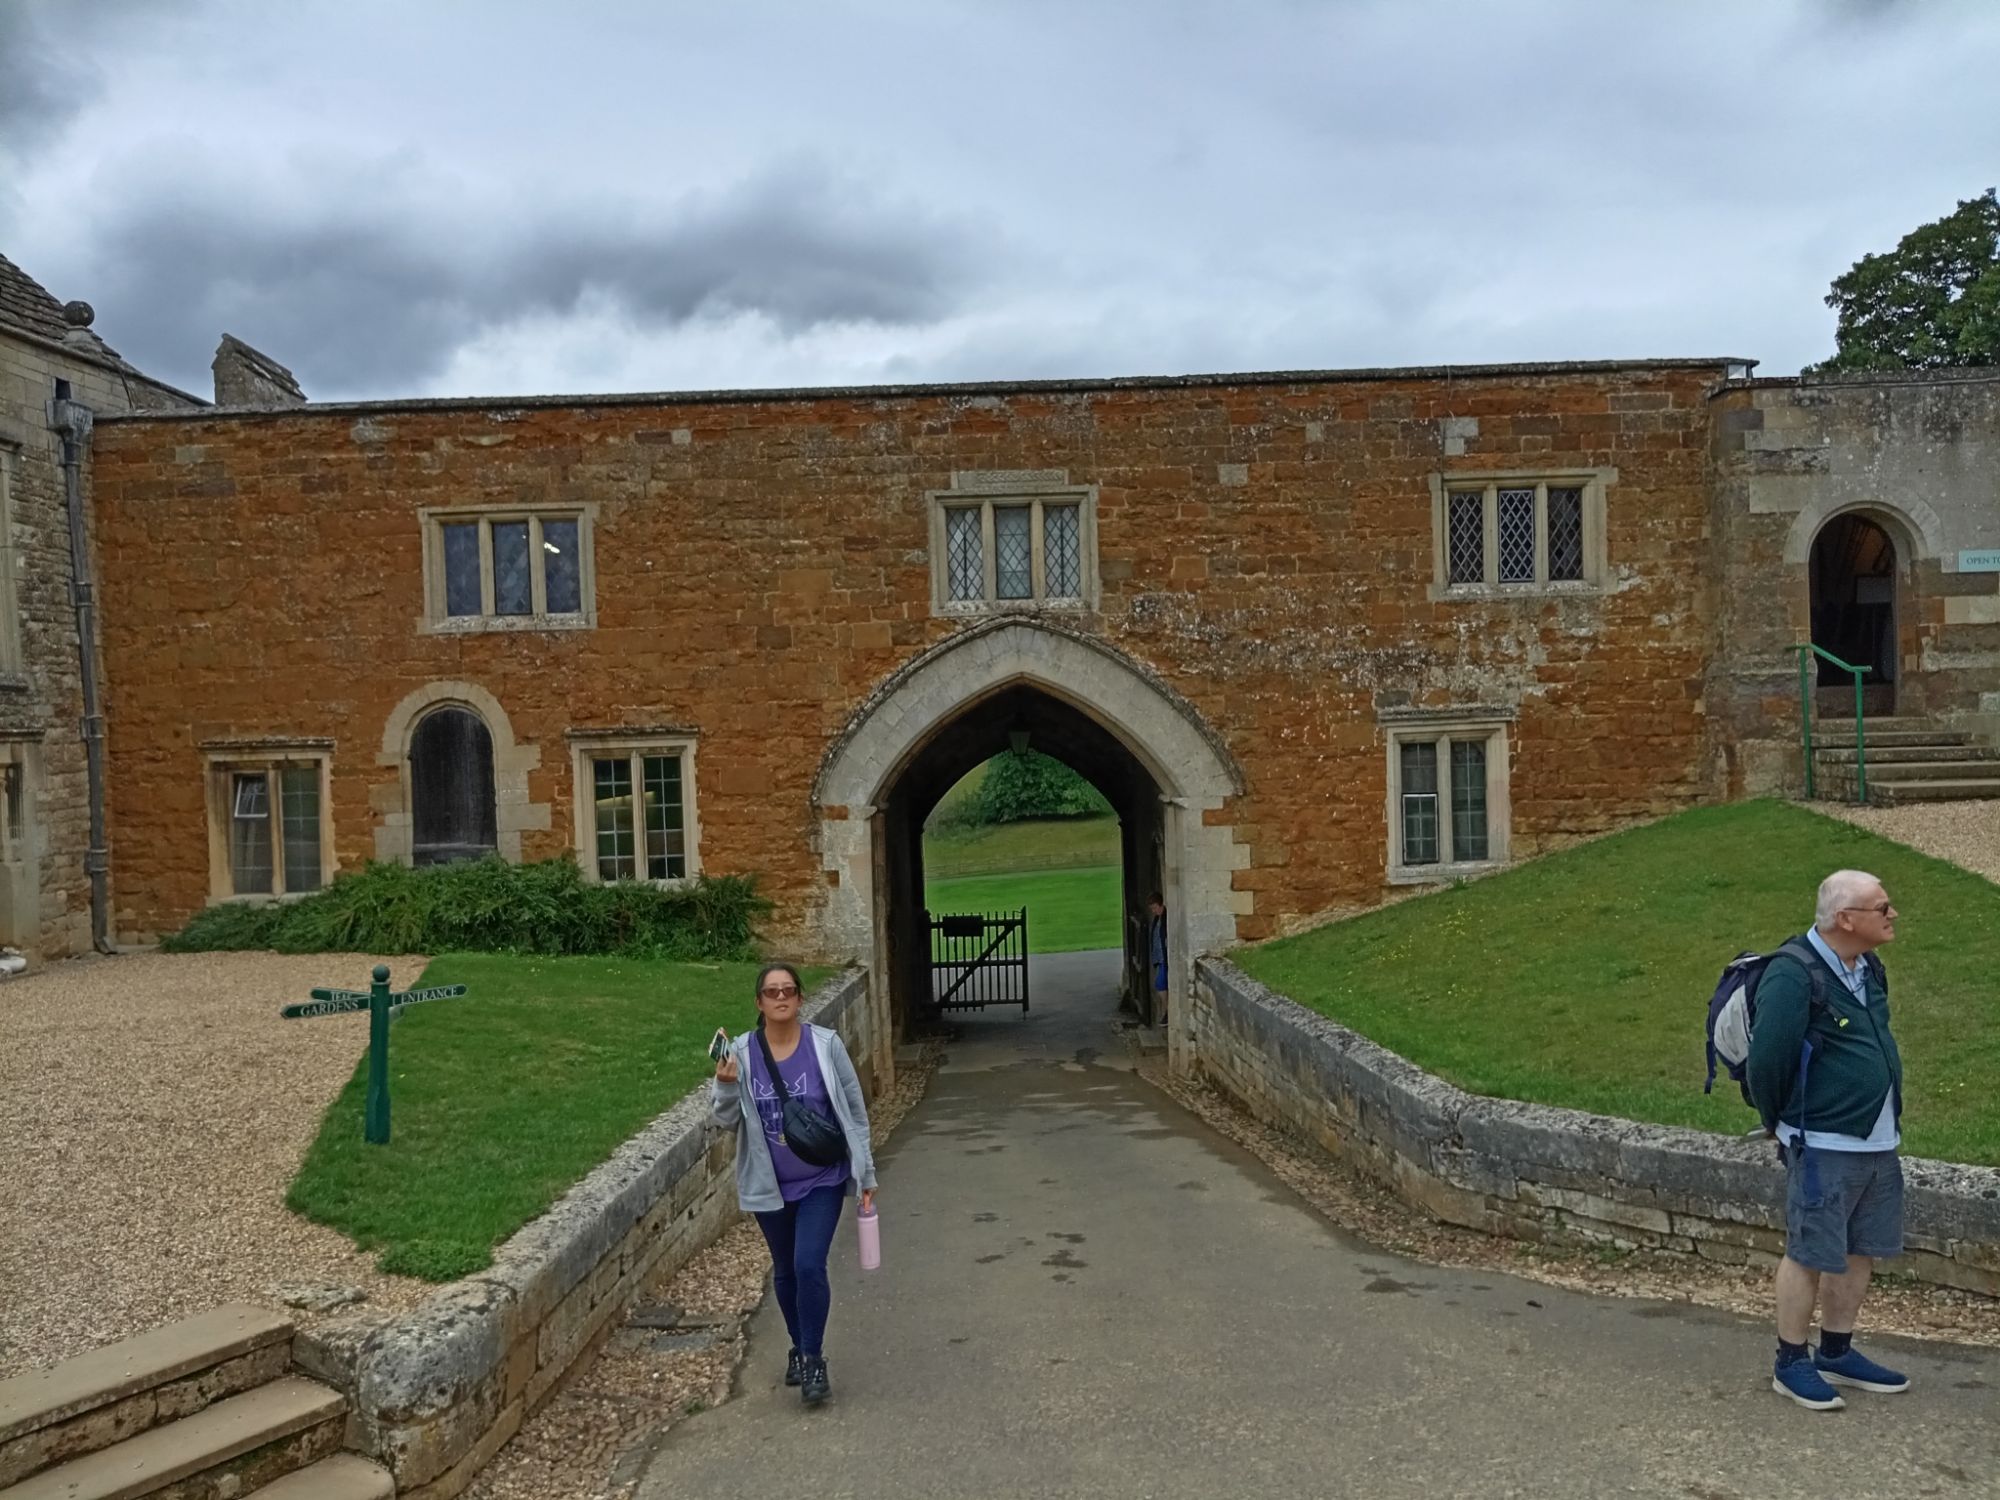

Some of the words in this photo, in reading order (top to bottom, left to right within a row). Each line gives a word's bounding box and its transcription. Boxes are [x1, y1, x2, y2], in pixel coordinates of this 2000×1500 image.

[1966, 556, 1990, 565] OPEN
[401, 985, 457, 1004] ENTRANCE
[300, 999, 359, 1017] GARDENS
